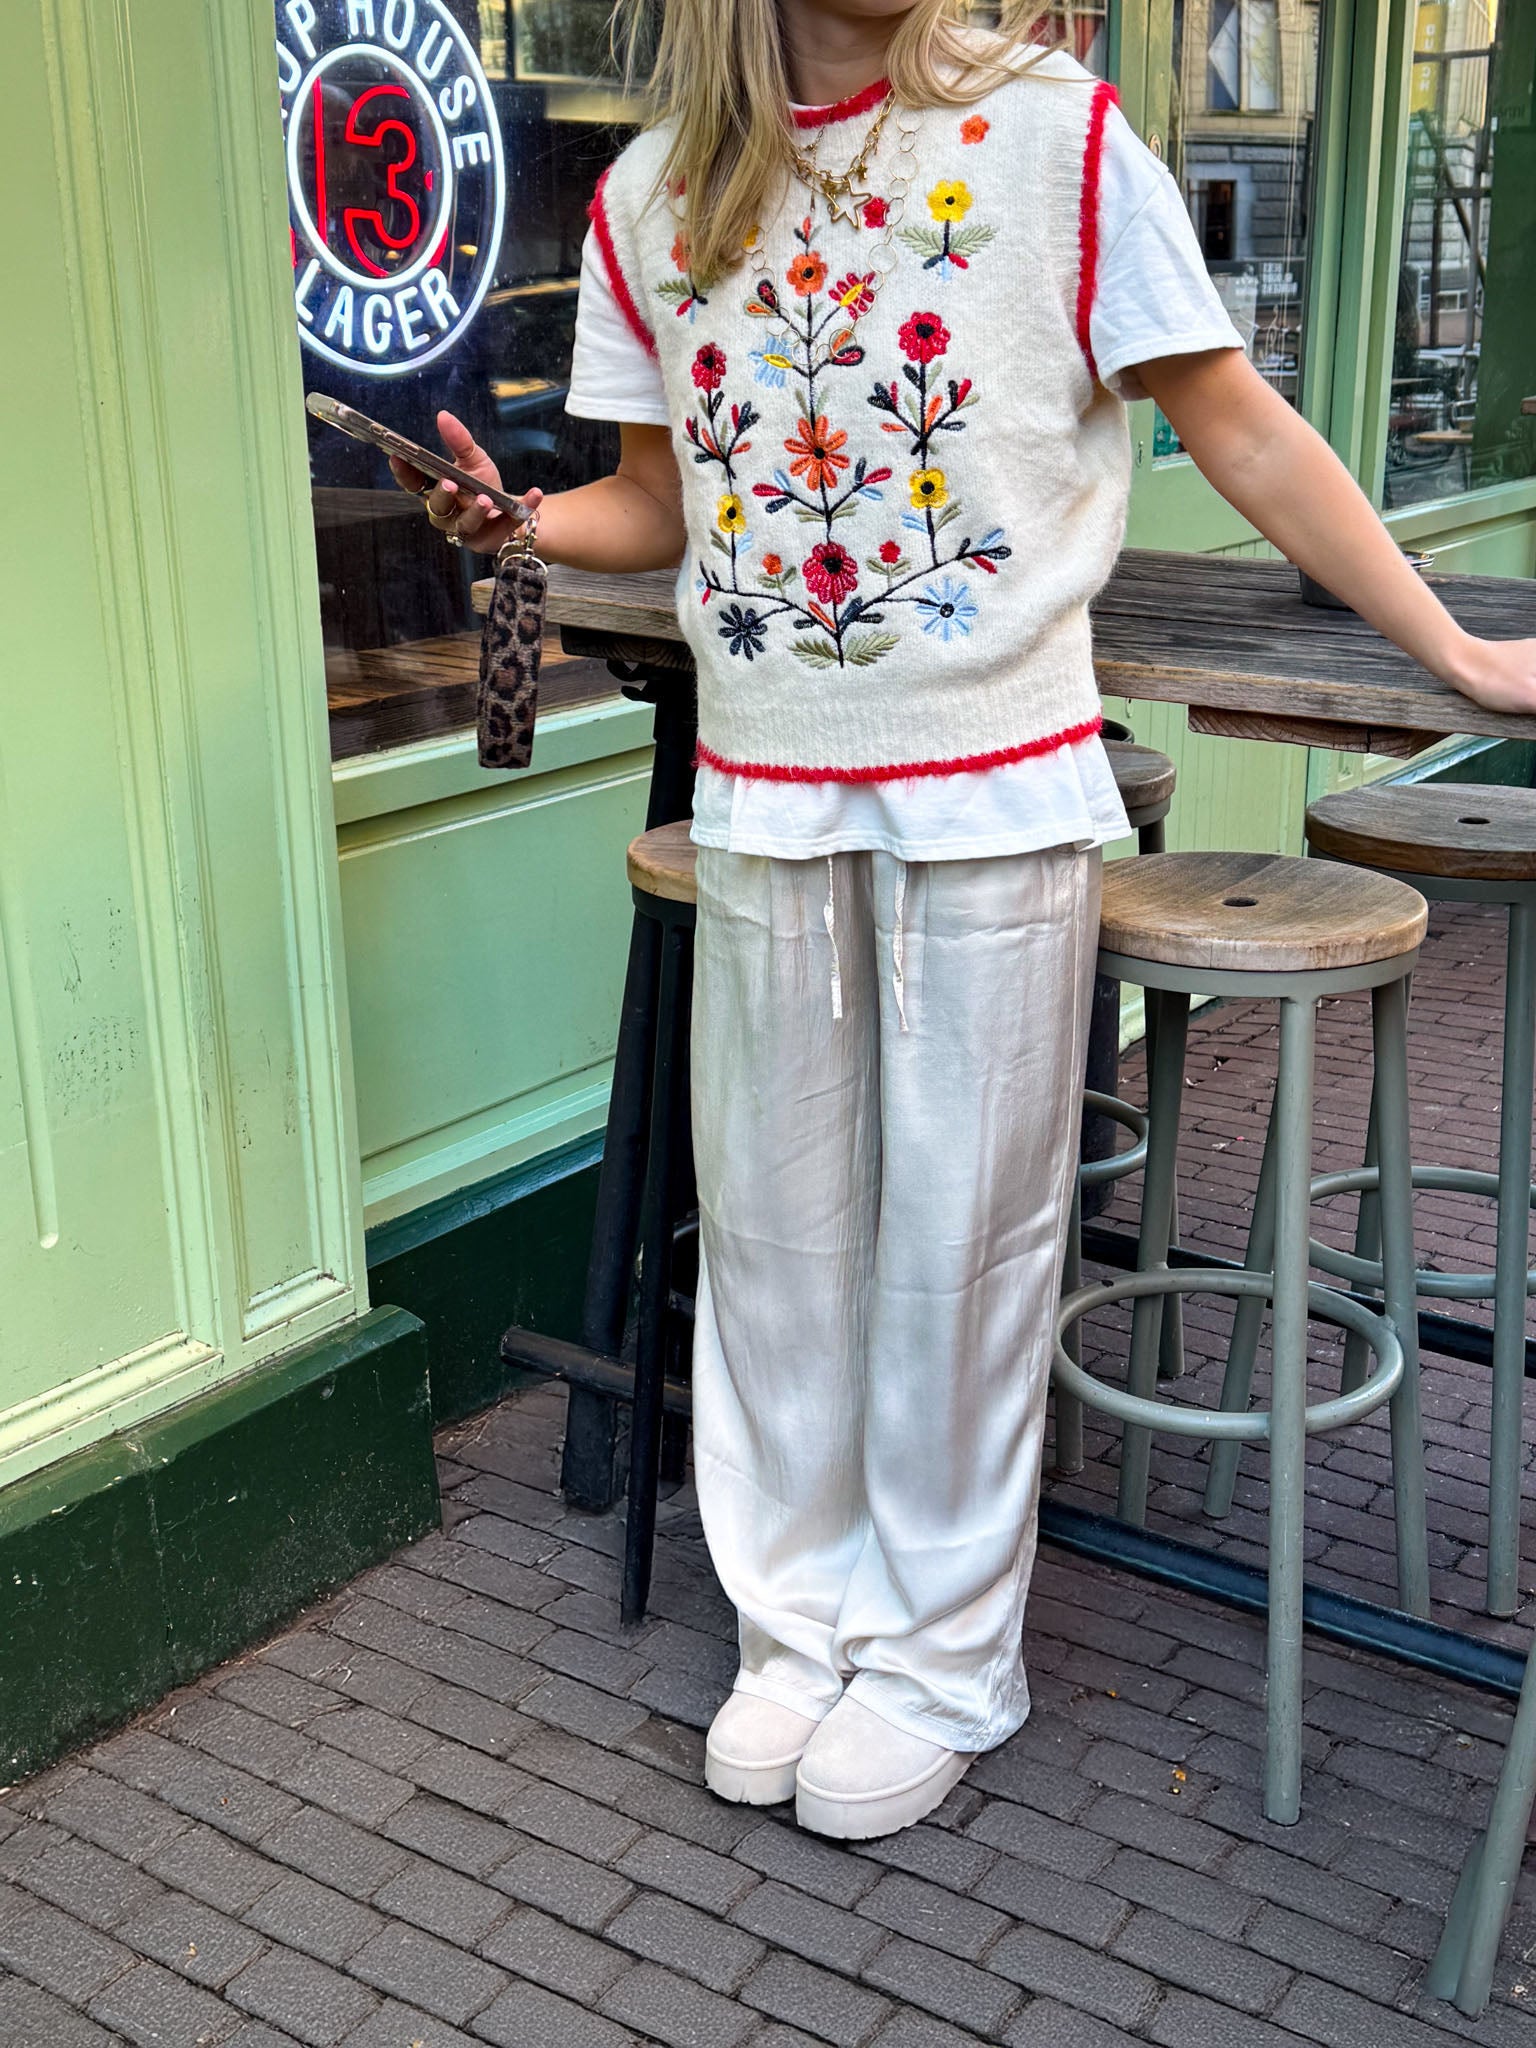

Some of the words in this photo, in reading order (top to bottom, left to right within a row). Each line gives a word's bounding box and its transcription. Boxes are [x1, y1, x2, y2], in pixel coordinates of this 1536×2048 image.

[275, 0, 317, 118] OP
[348, 0, 491, 169] HOUSE
[295, 258, 461, 354] LAGER
